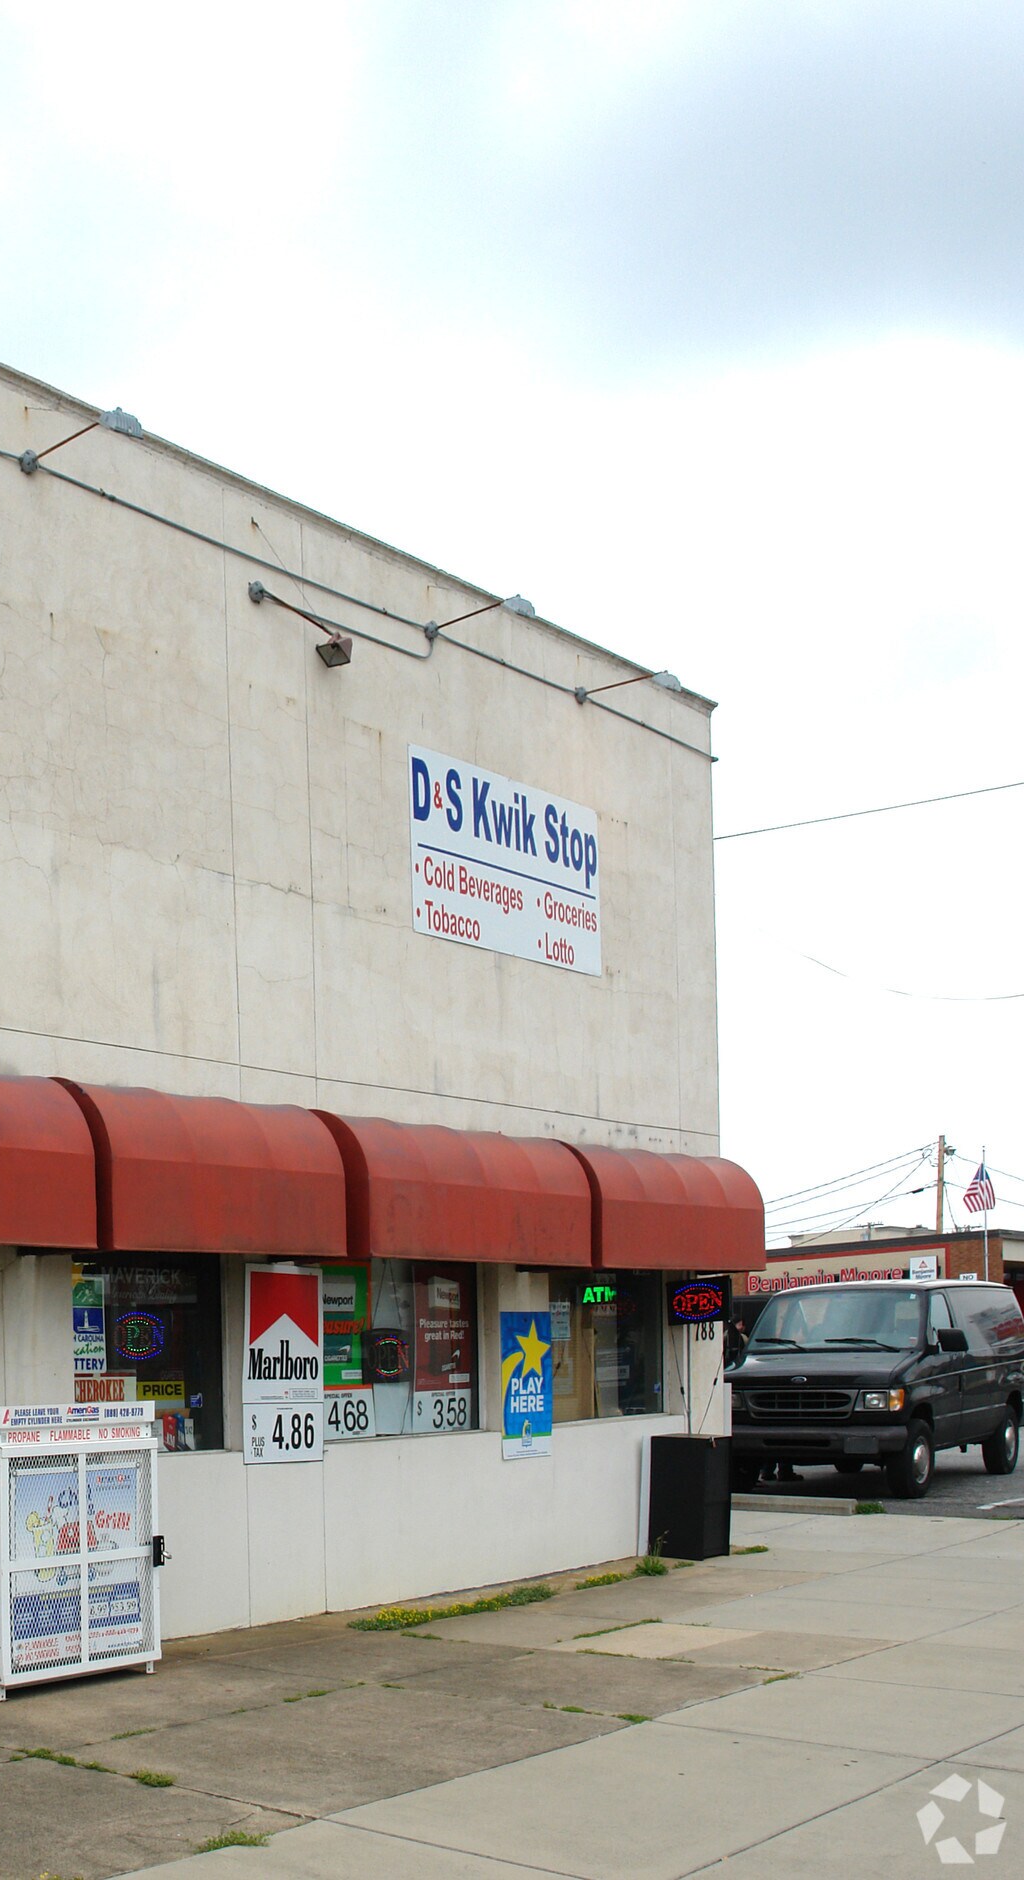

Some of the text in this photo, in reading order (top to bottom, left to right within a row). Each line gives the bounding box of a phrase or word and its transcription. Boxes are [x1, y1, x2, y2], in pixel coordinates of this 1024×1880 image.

[412, 757, 597, 889] D&S Kwik Stop
[424, 856, 523, 914] Cold Beverages
[425, 900, 481, 941] Tobacco
[544, 892, 597, 932] Groceries
[545, 932, 575, 965] Lotto
[101, 1266, 181, 1284] MAVERICK
[748, 1267, 904, 1292] Benjamin Moore
[672, 1291, 723, 1311] OPEN
[419, 1318, 469, 1328] Pleasure tastes
[77, 1334, 104, 1343] CAROLINA
[424, 1330, 465, 1342] great in Red!
[248, 1340, 319, 1380] Marlboro
[74, 1380, 125, 1402] CHEROKEE
[143, 1384, 182, 1396] PRICE
[511, 1377, 544, 1395] PLAY
[14, 1407, 59, 1417] PLEASE LEAVE YOUR
[66, 1406, 100, 1415] AmeriGas
[433, 1397, 467, 1430] 3.58
[510, 1395, 544, 1413] HERE
[11, 1416, 63, 1426] EMPTY CYLINDER HERE
[328, 1400, 369, 1434] 4.68
[8, 1431, 41, 1443] PROPANE
[50, 1429, 91, 1441] FLAMMABLE
[98, 1428, 108, 1440] NO
[111, 1426, 141, 1439] SMOKING
[273, 1413, 315, 1450] 4.86
[251, 1436, 265, 1447] PLUS
[253, 1447, 263, 1457] TAX
[95, 1510, 131, 1531] Grill!
